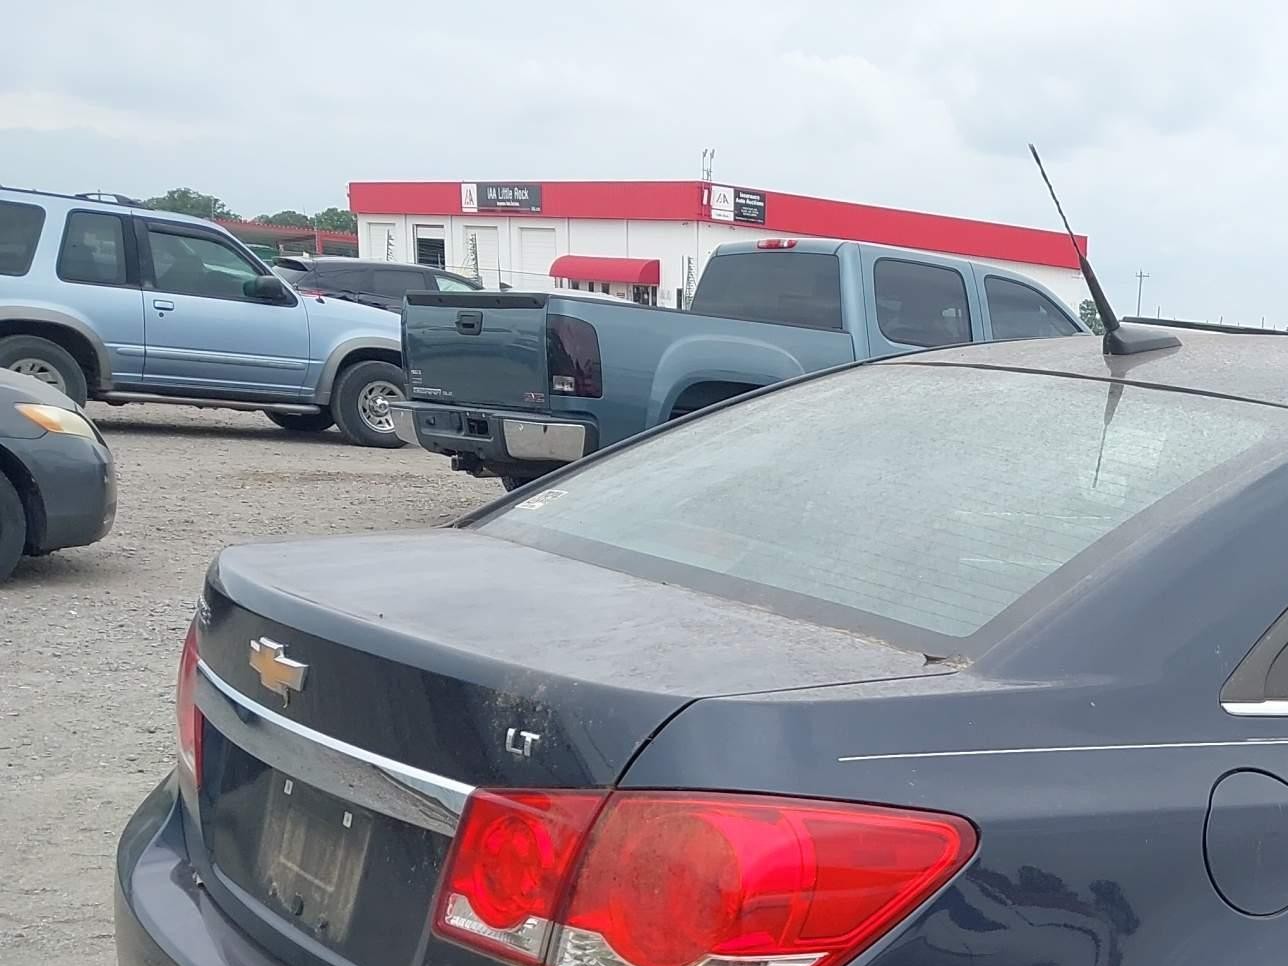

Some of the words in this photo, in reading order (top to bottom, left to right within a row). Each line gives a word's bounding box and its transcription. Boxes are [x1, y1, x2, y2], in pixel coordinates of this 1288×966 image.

[498, 187, 513, 200] Little
[514, 187, 529, 200] Rock
[505, 727, 541, 757] LT
